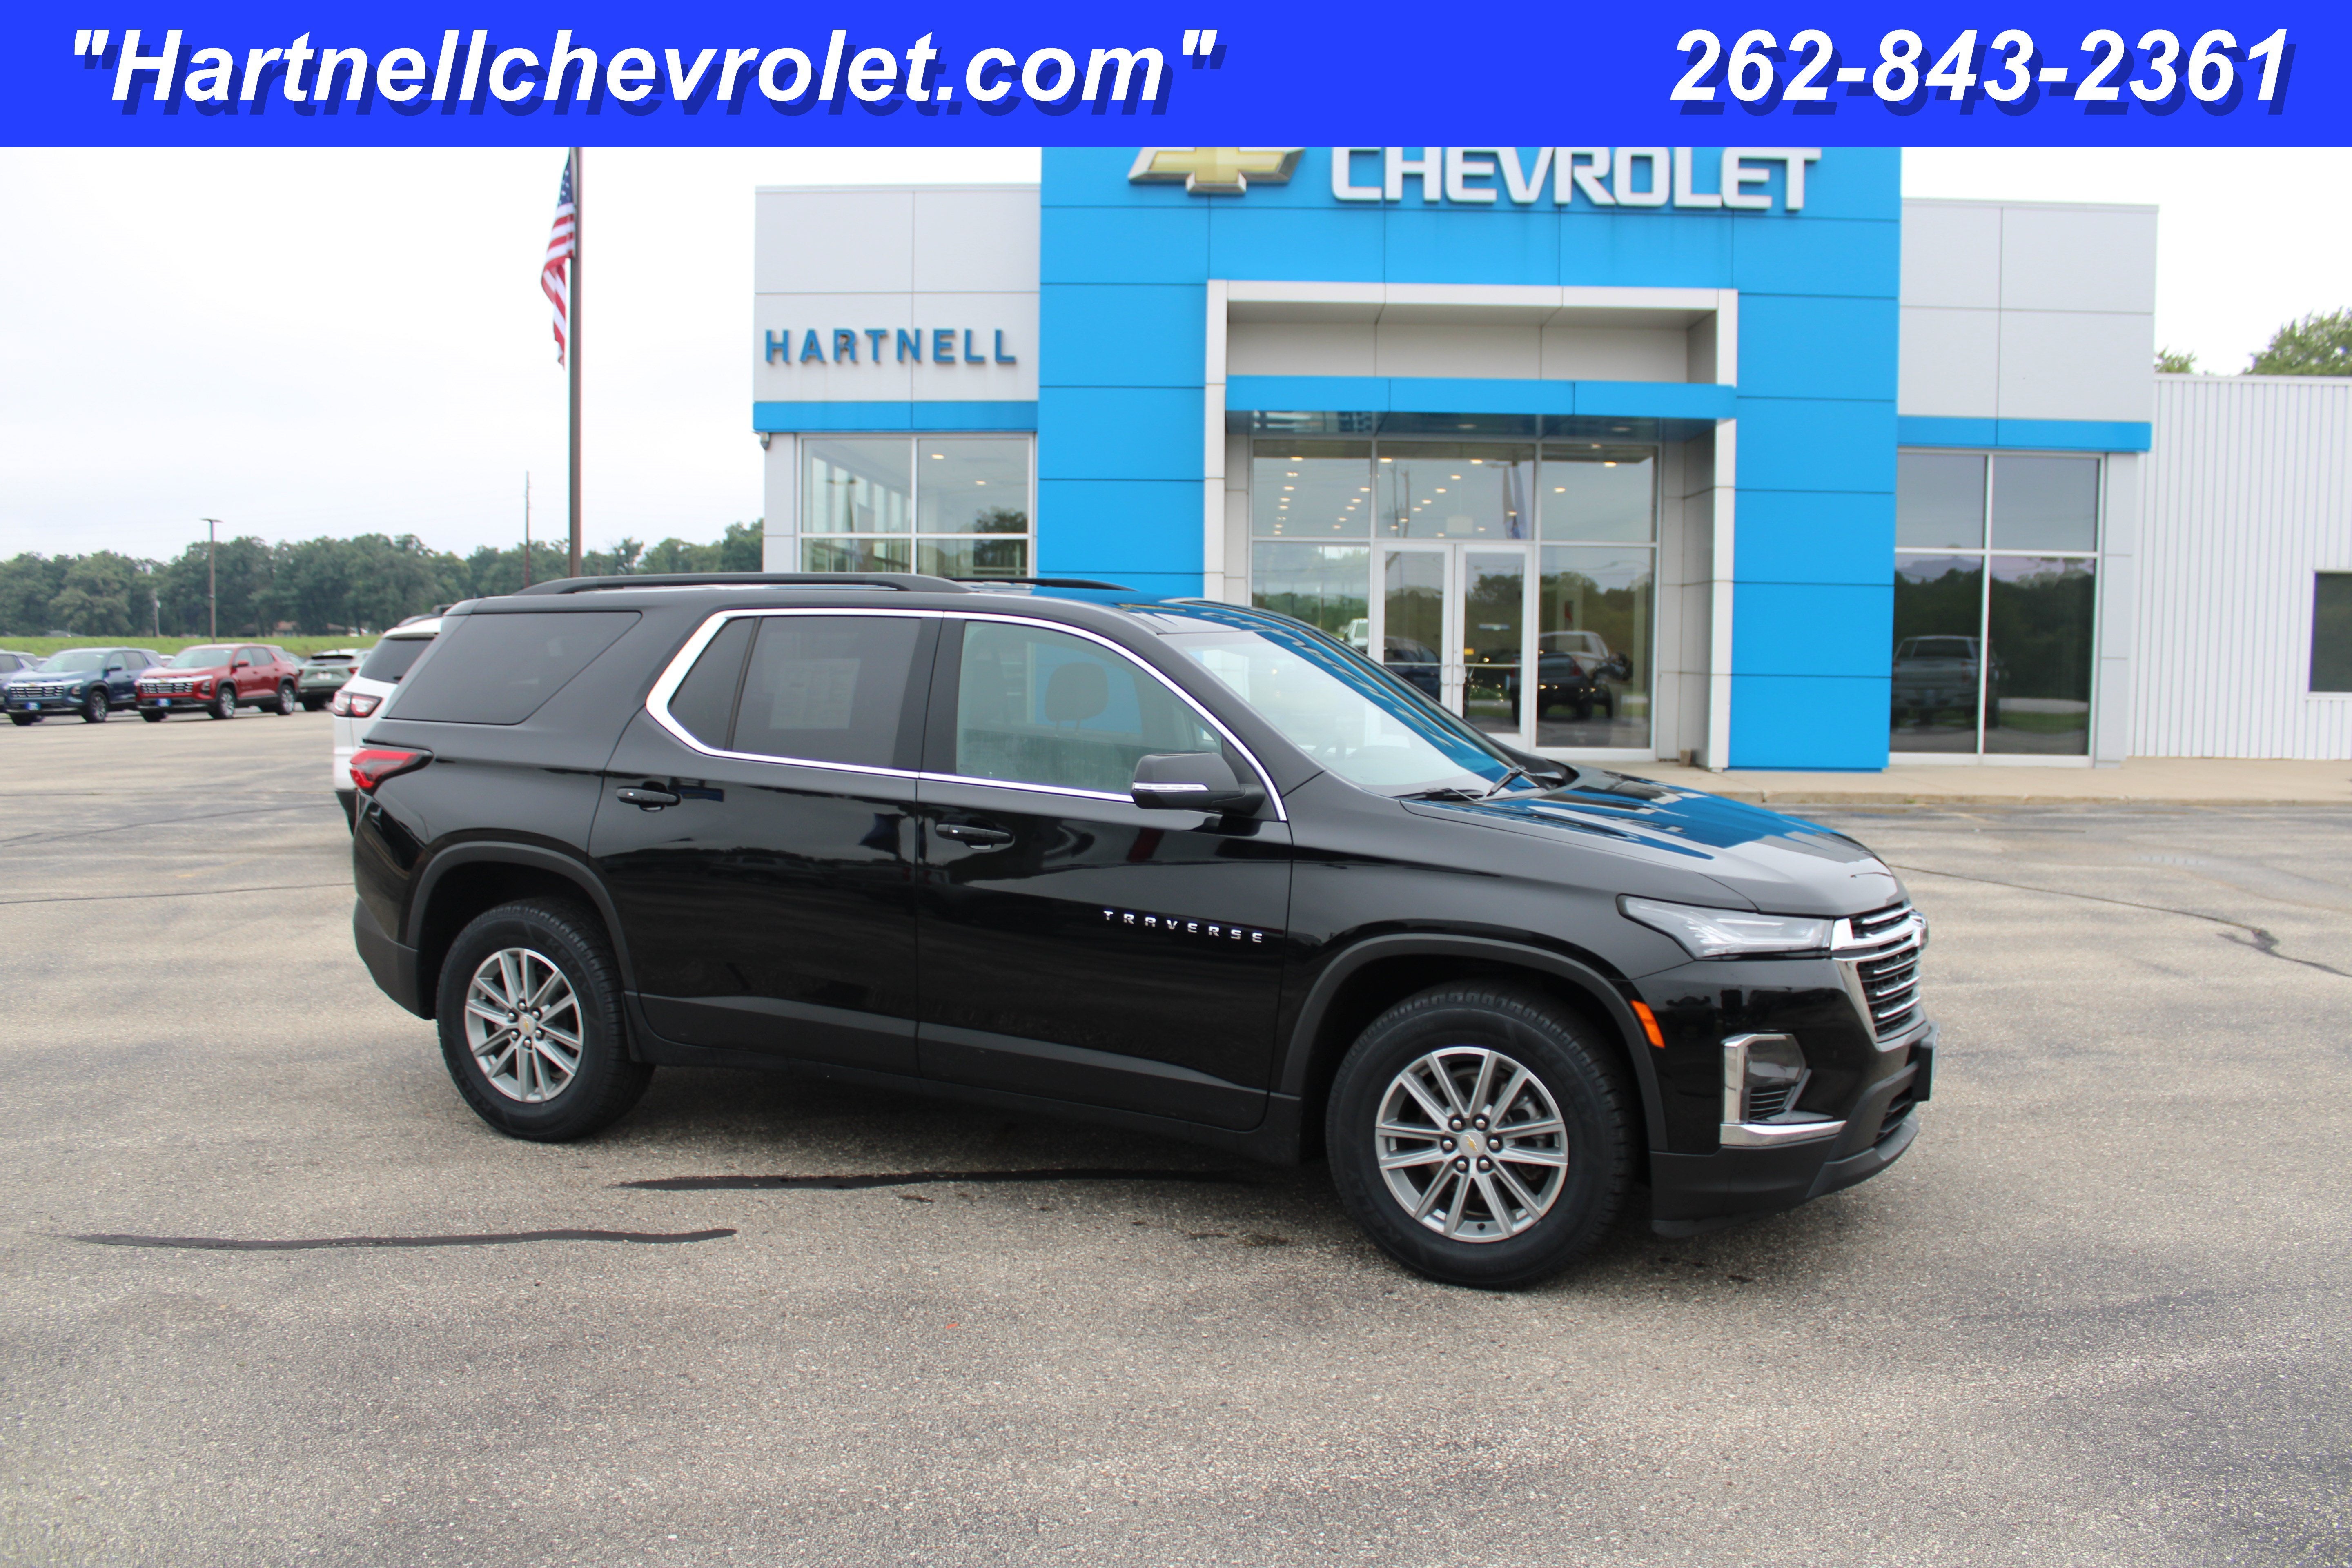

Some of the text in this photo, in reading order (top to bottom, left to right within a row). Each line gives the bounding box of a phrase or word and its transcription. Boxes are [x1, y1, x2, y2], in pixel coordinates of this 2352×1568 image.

[1331, 146, 1822, 210] CHEVROLET
[764, 327, 1018, 364] HARTNELL
[1103, 910, 1263, 944] TRAVERSE
[546, 937, 590, 994] KELLY
[1534, 1045, 1594, 1123] KELLY
